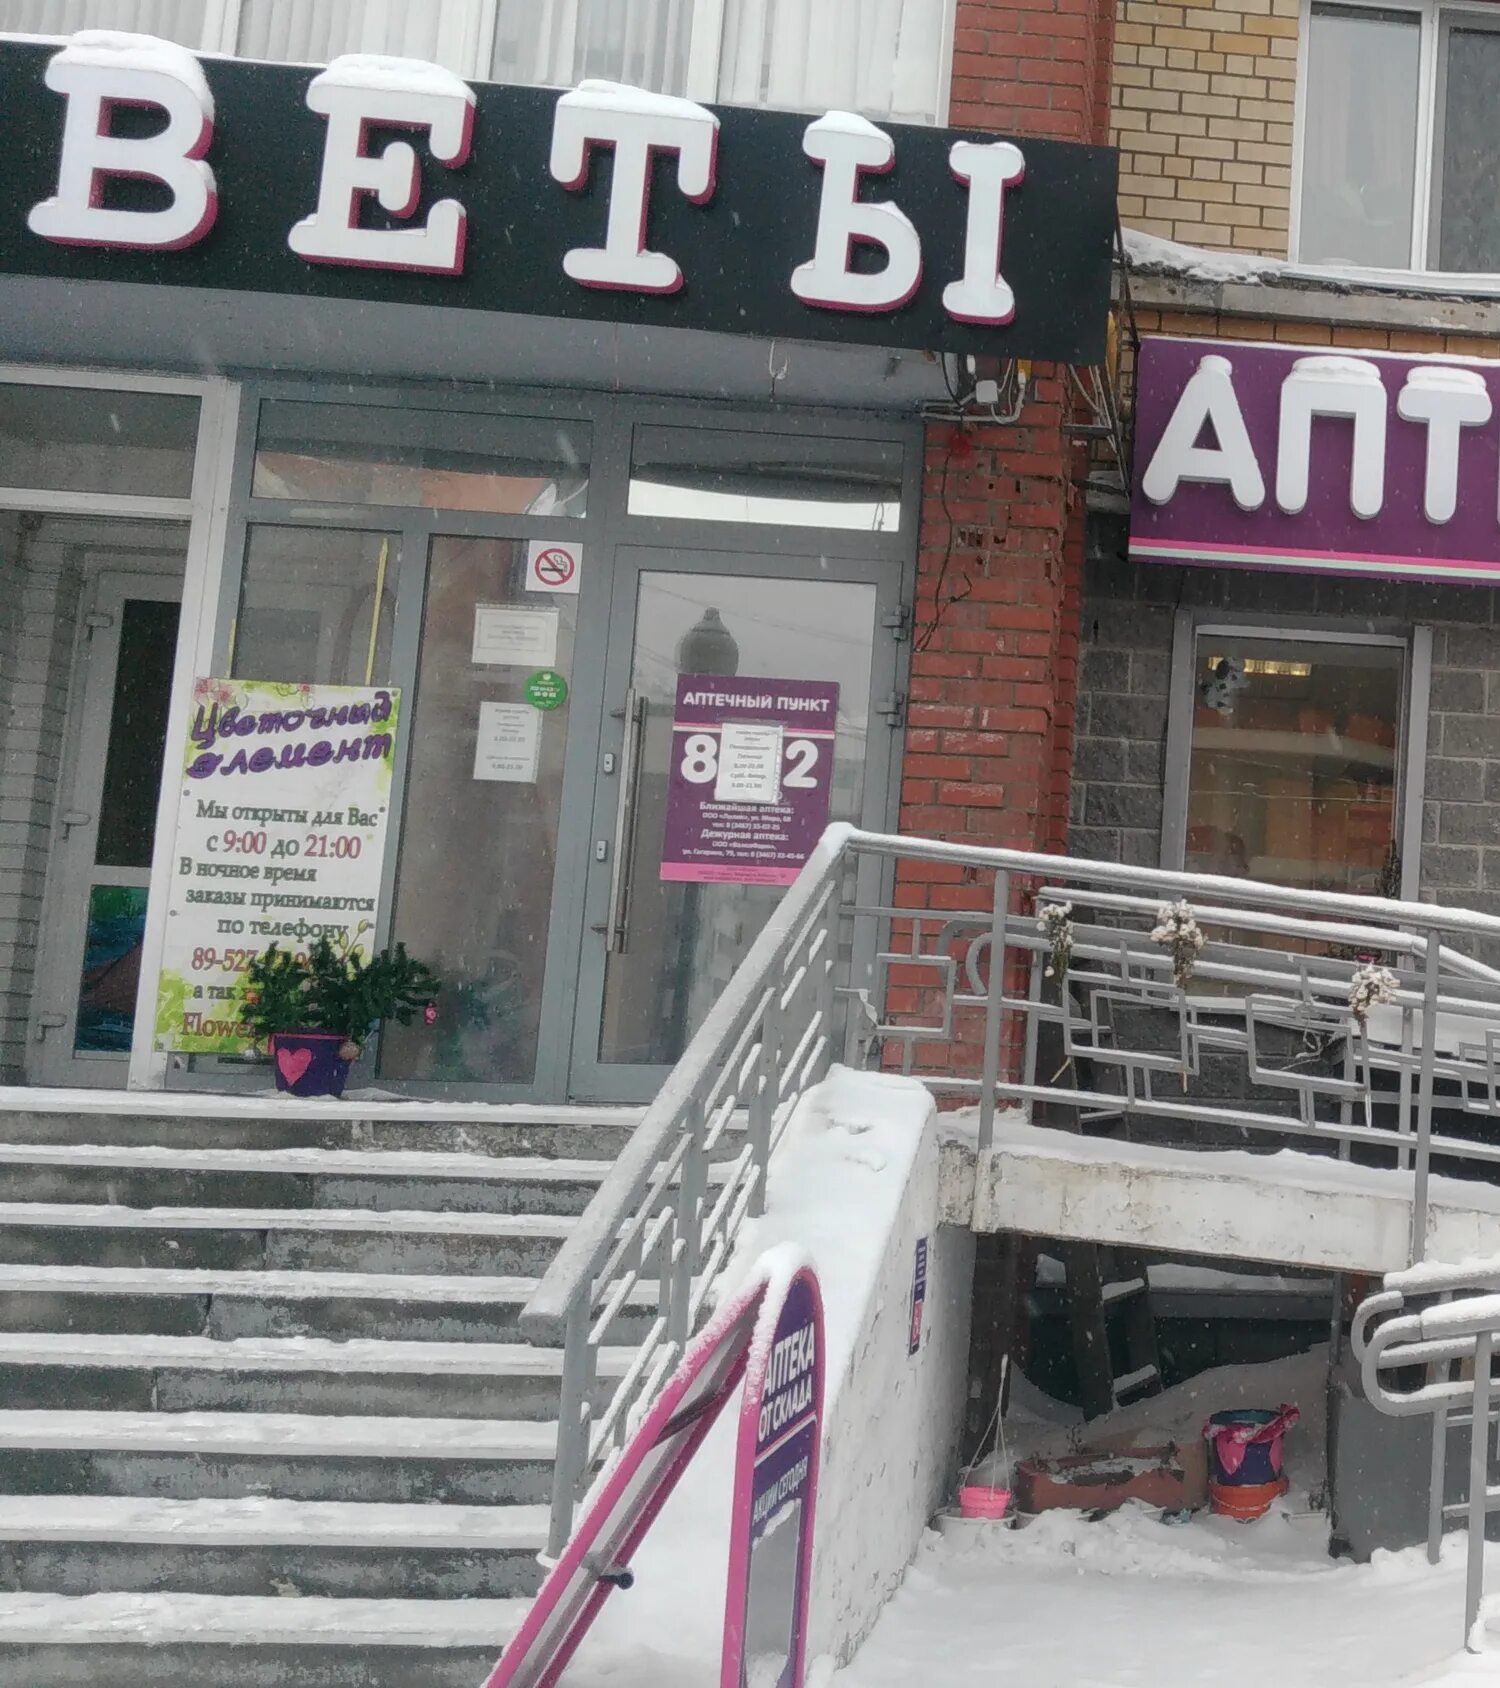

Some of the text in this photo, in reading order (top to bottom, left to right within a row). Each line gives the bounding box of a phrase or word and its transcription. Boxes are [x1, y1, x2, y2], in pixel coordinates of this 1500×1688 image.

[683, 692, 830, 712] АПТЕЧНЫЙ ПУНКТ
[196, 800, 378, 827] Мы открыты для Вас
[206, 830, 361, 859] с 9:00 до 21:00
[179, 857, 317, 886] В ночное время
[185, 889, 375, 912] заказы принимаются
[217, 917, 350, 943] по телефону
[193, 985, 203, 999] а
[762, 1322, 815, 1401] АПТЕКА
[758, 1374, 812, 1441] ОТ СКЛАДА
